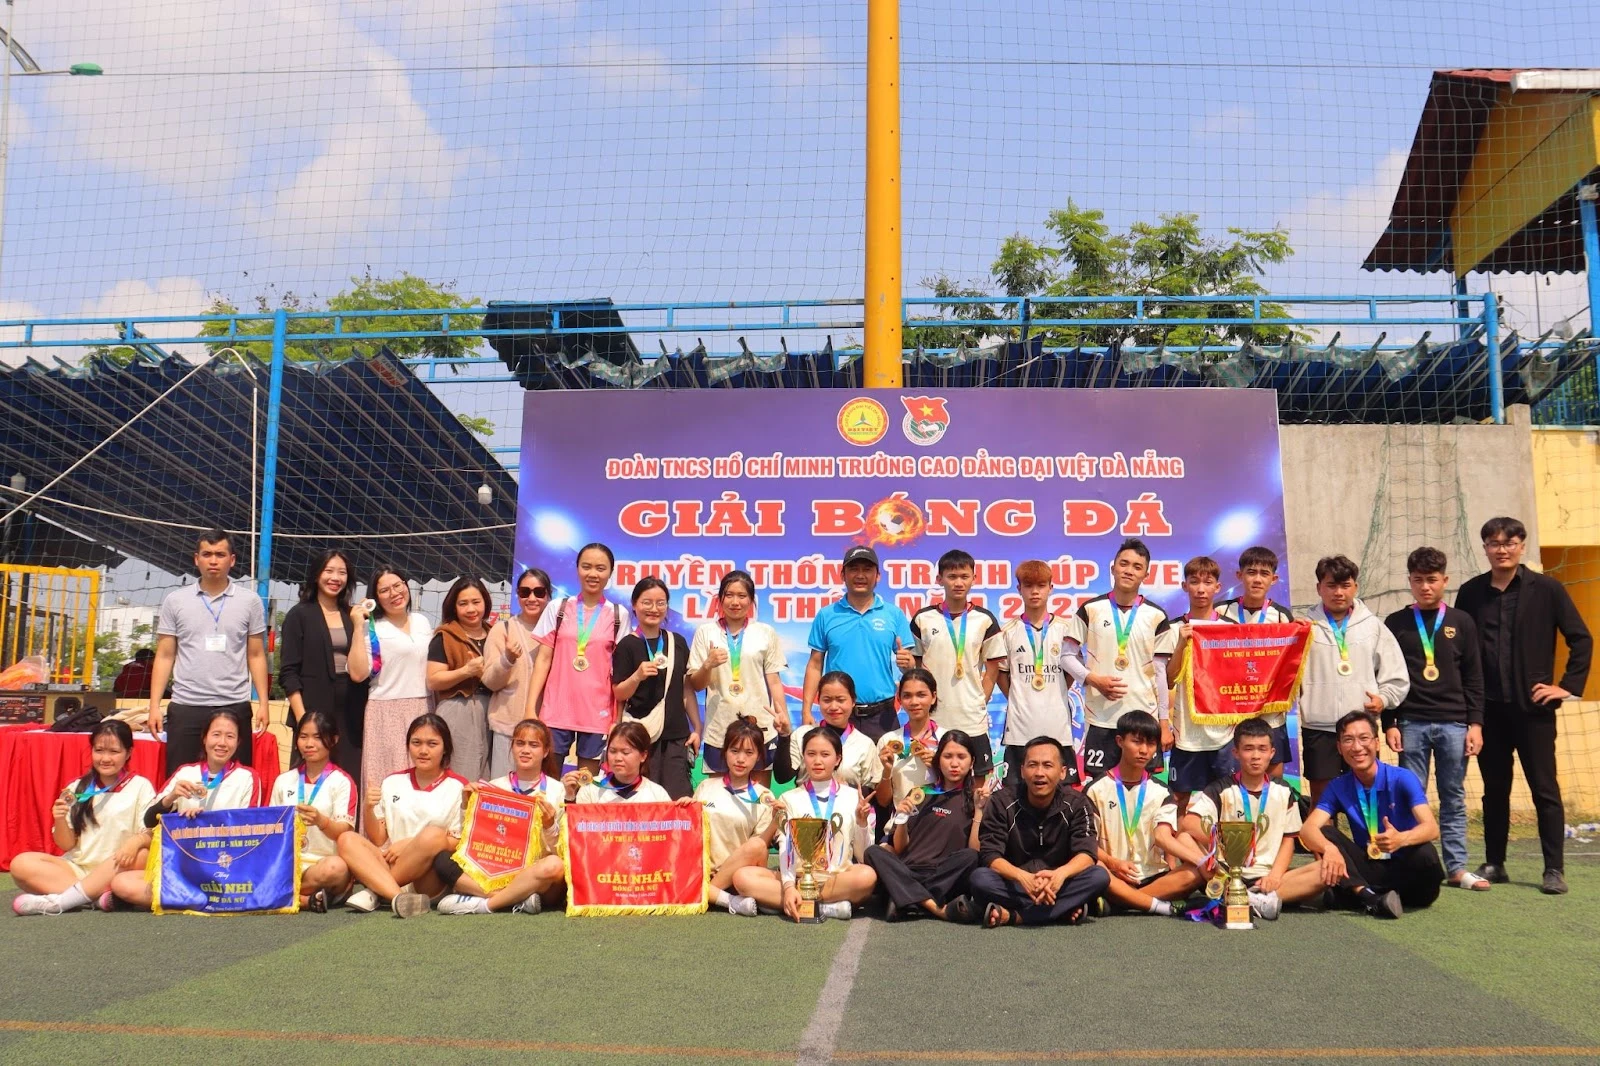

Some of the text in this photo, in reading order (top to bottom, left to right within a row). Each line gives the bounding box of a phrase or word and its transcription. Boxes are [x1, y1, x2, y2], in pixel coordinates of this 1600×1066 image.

[606, 448, 1185, 481] ĐOÀN TNCS HỒ CHÍ MINH TRƯỜNG CAO ĐẲNG ĐẠI VIỆT ĐÀ NẴNG
[619, 492, 784, 536] GIẢI
[1064, 493, 1172, 537] ĐÁ
[608, 556, 734, 587] RUYỀN
[748, 555, 845, 587] THỐN
[885, 561, 1009, 587] TRH
[1050, 557, 1097, 587] ÚP
[1018, 663, 1062, 674] Emates
[1220, 683, 1270, 695] GIẢI NH
[1087, 749, 1104, 767] 22
[597, 869, 672, 885] GIẢI NHẤT
